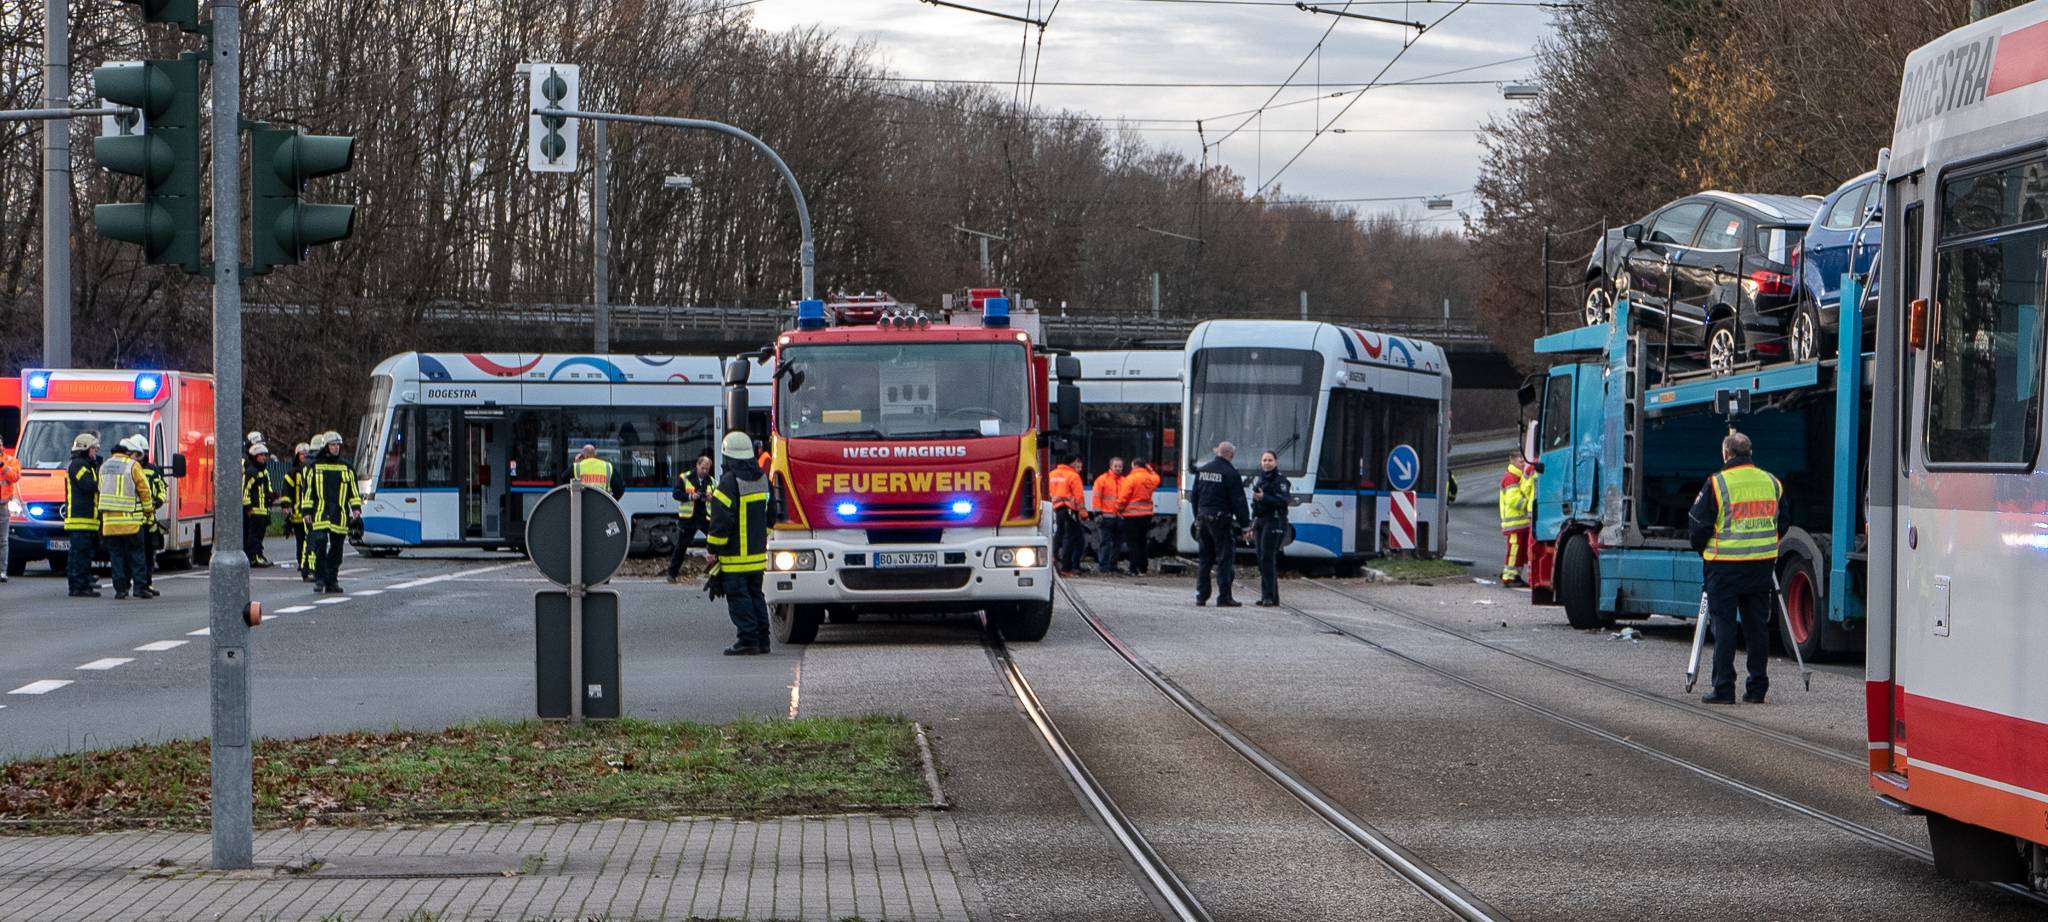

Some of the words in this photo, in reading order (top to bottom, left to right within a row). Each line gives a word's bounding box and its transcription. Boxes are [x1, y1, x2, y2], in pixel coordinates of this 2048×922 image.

[1896, 35, 1994, 134] BOGESTRA
[428, 389, 477, 399] BOGESTRA
[843, 447, 890, 458] IVECO
[894, 446, 967, 457] MAGIRUS
[816, 471, 992, 494] FEUERWEHR
[880, 554, 892, 565] BO
[898, 554, 910, 565] SV
[912, 553, 935, 564] 3719
